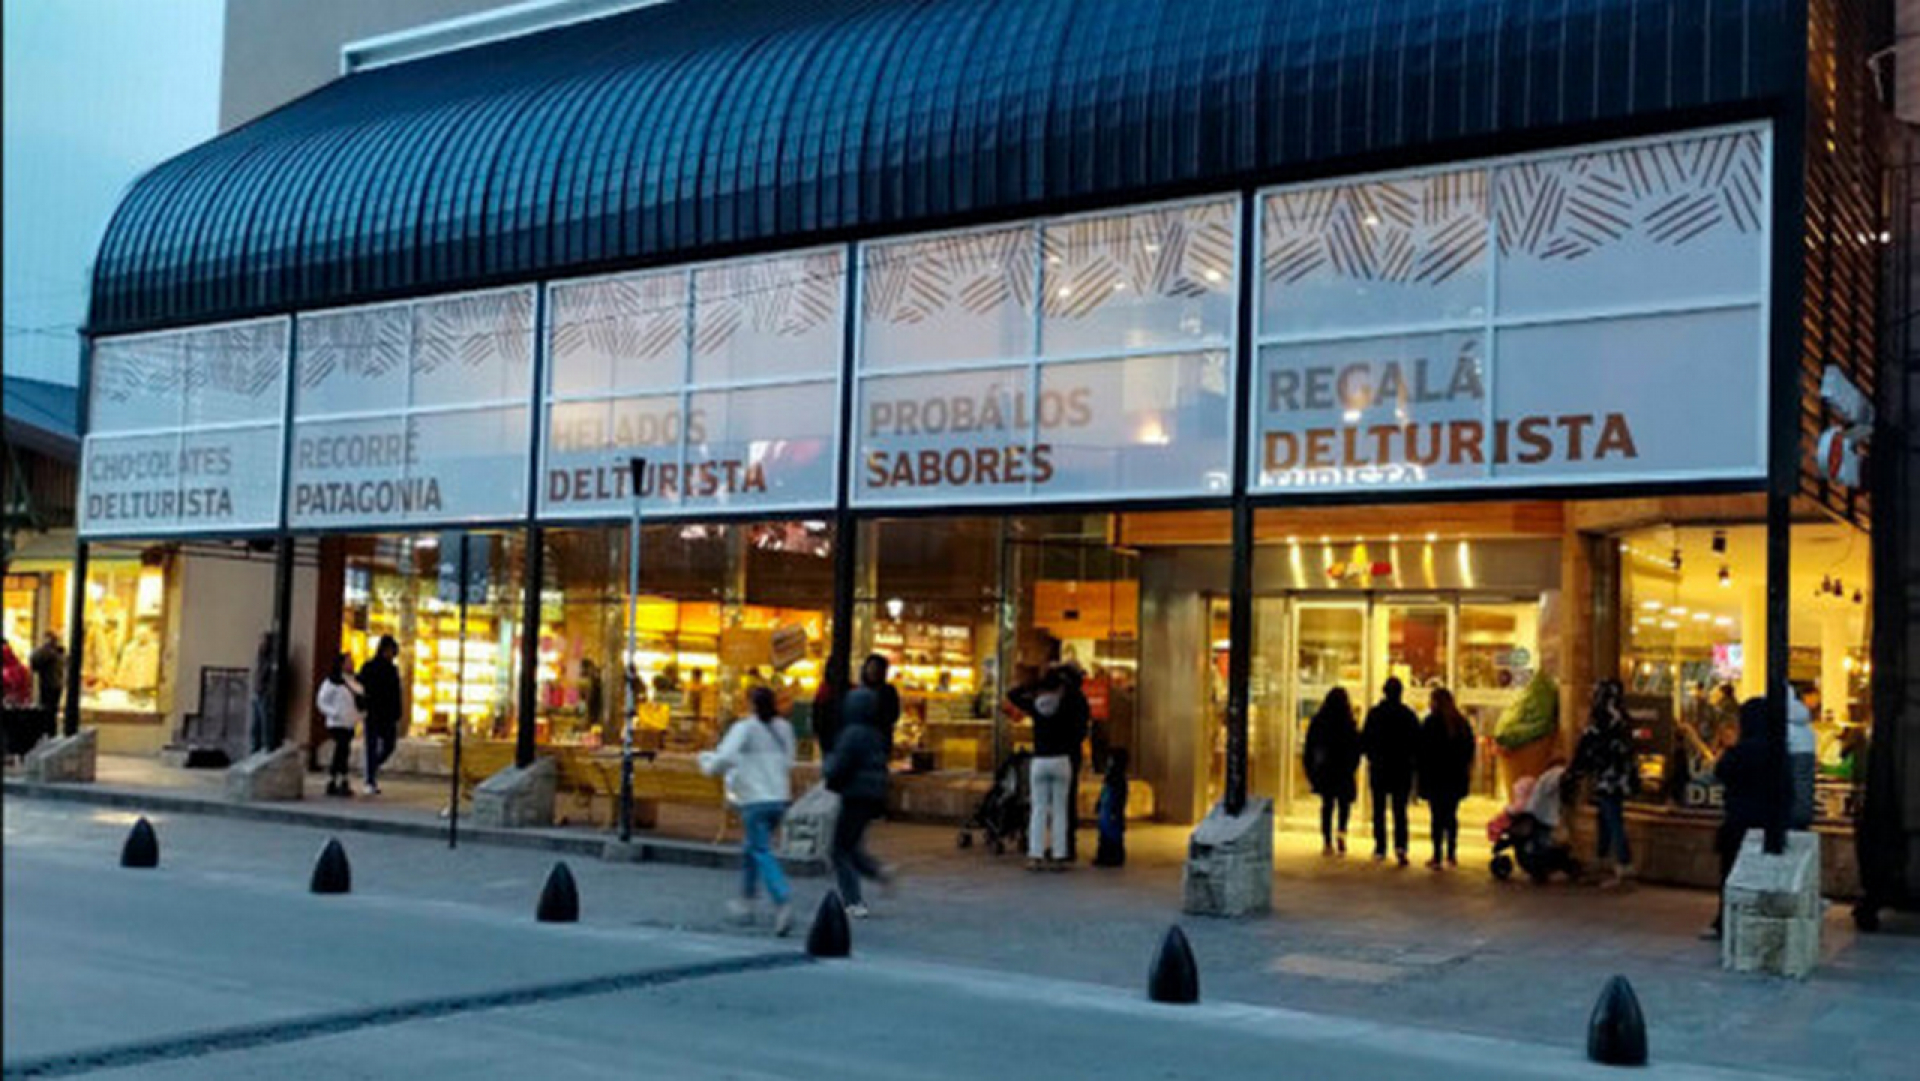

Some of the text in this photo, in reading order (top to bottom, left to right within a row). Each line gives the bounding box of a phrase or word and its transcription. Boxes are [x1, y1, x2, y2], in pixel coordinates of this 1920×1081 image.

[1268, 340, 1485, 411] REGALÁ
[869, 384, 1093, 436] PROBÁ LOS
[88, 445, 231, 482] CHOCOLATES
[1263, 413, 1637, 471] DELTURISTA
[549, 457, 766, 502] DELTURISTA
[867, 443, 1054, 488] SABORES
[87, 487, 233, 520] DELTURISTA
[296, 475, 441, 515] PATAGONIA
